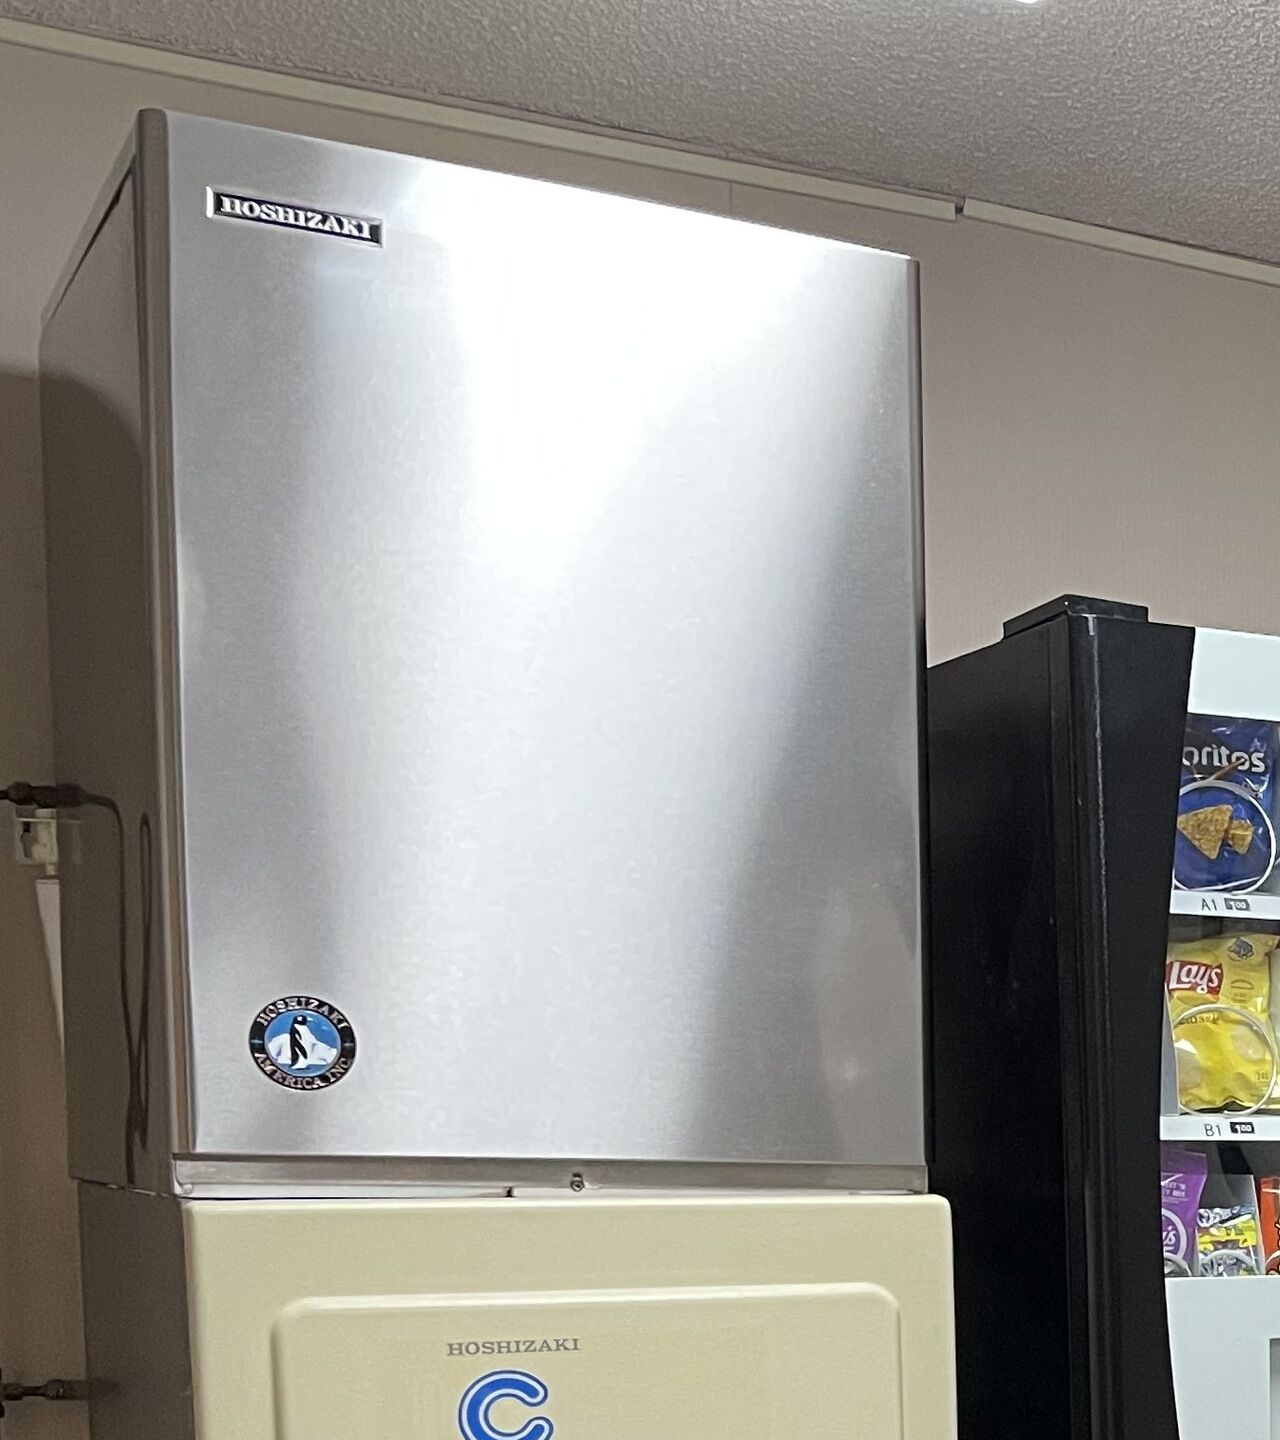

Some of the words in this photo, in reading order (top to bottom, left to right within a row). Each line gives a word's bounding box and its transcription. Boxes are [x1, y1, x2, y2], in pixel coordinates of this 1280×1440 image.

[219, 195, 373, 239] HOSHIZAKI
[1182, 743, 1266, 773] oritos
[1201, 898, 1218, 912] A1
[256, 997, 351, 1029] HOSHIZAKI
[1204, 1124, 1222, 1137] B1
[446, 1337, 581, 1357] HOSHIZAKI
